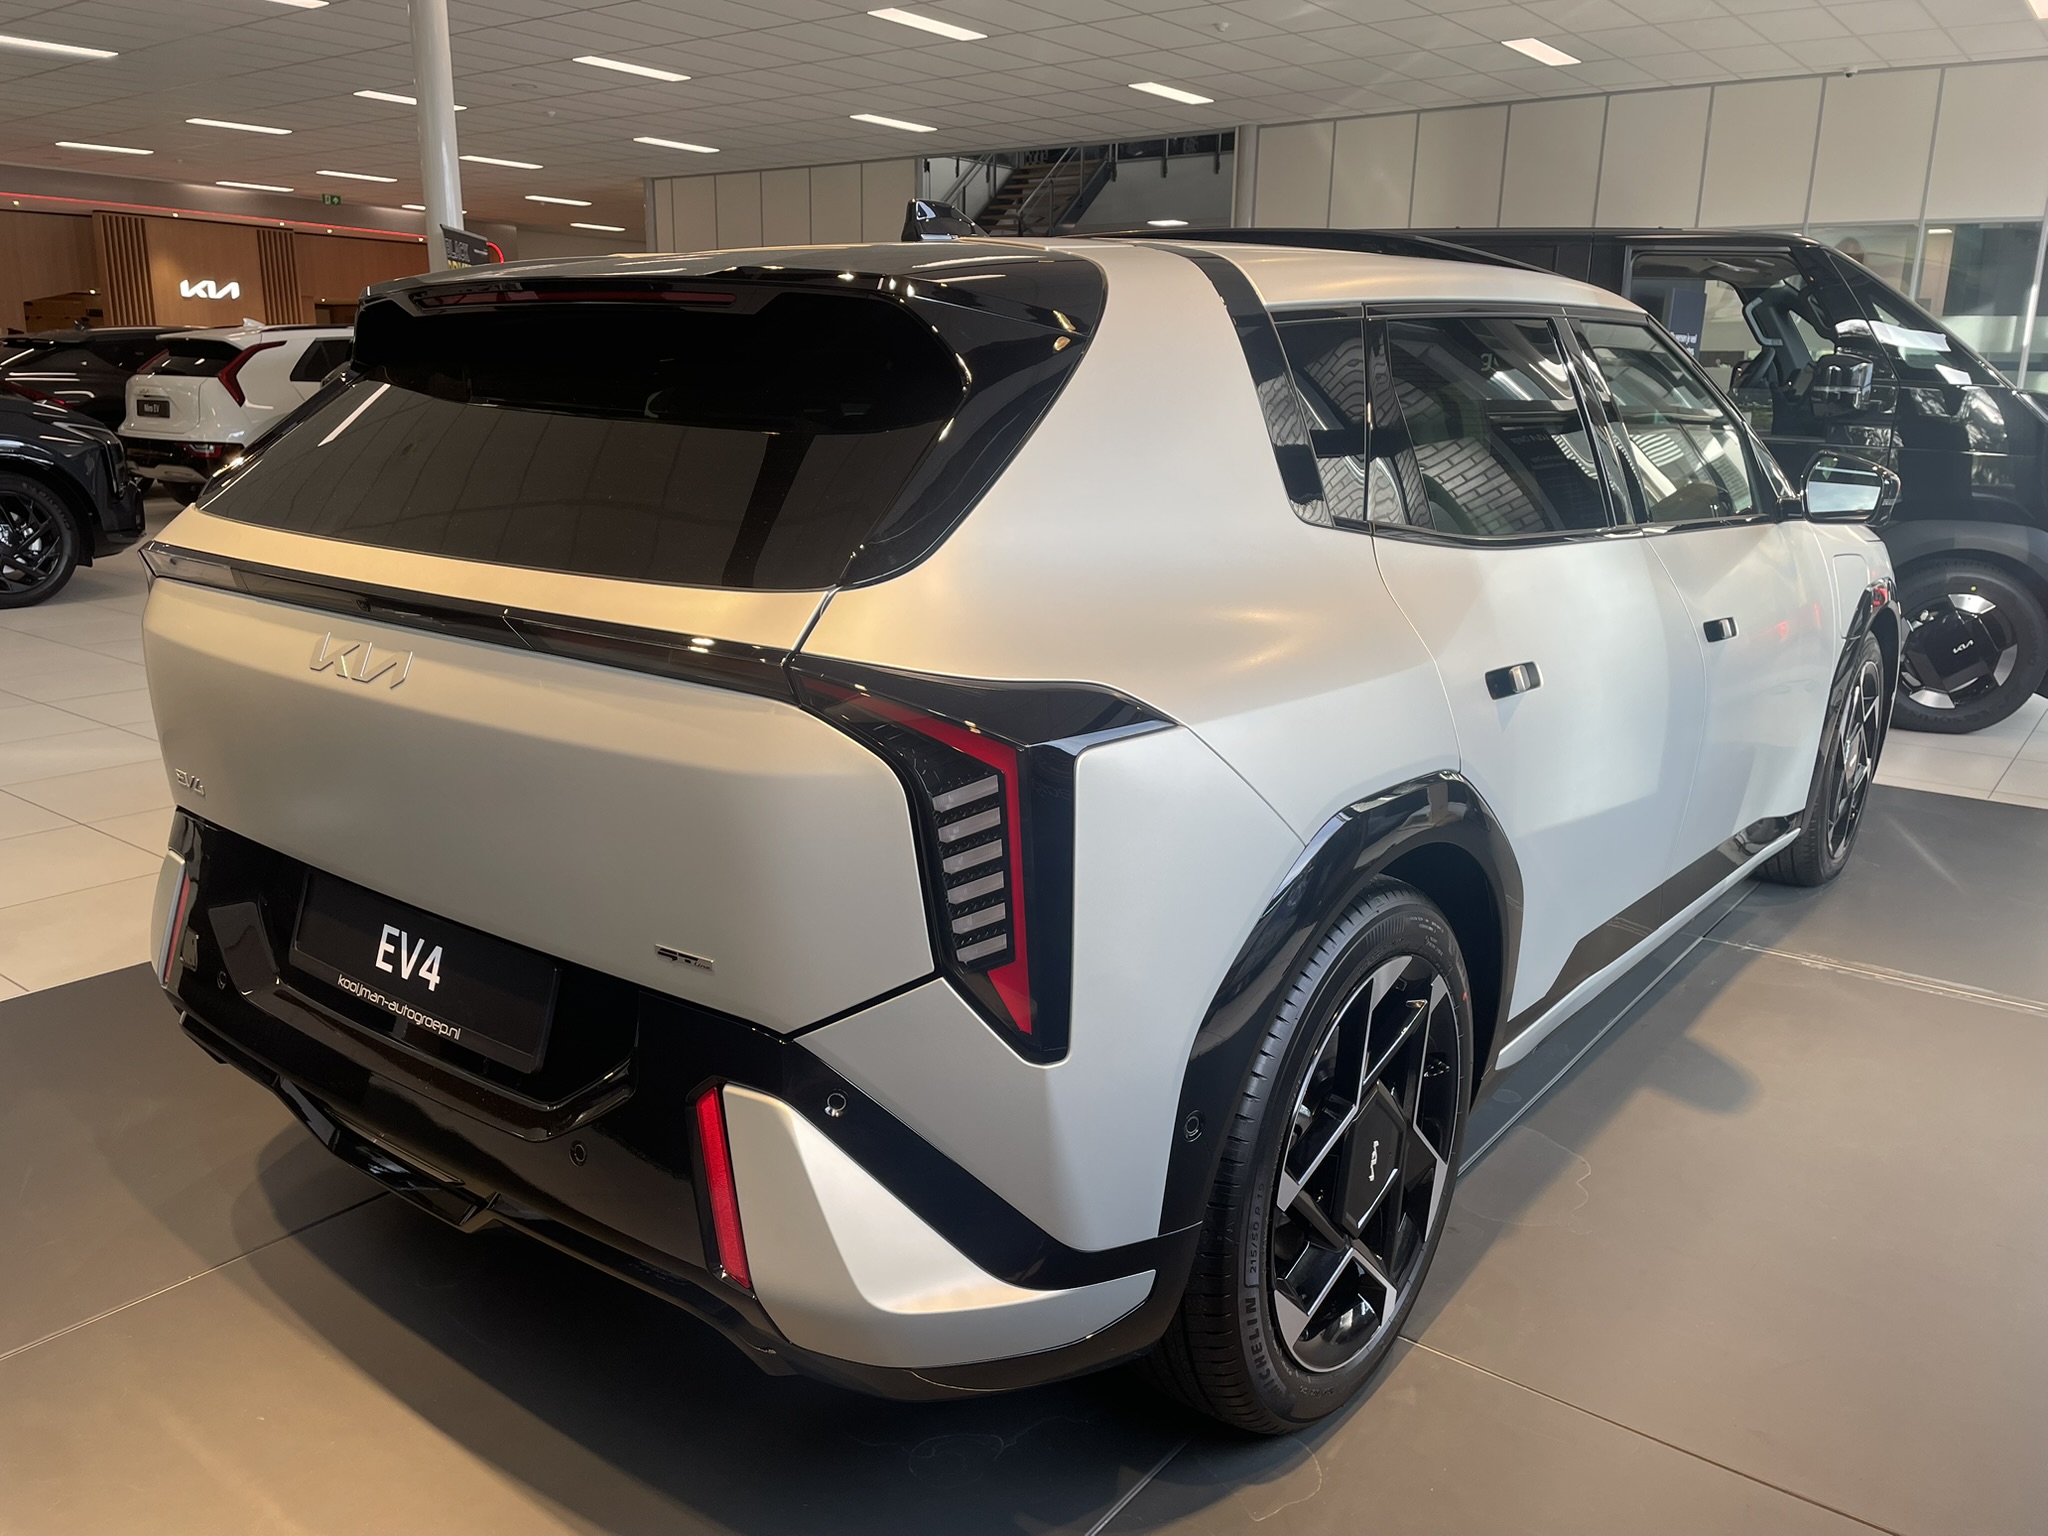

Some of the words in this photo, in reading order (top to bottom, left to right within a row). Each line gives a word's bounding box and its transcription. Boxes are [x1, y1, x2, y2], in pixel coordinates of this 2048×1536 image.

[179, 279, 241, 300] KIA
[153, 403, 160, 413] EV
[309, 631, 413, 690] KIA
[1952, 639, 1974, 654] KIA
[175, 768, 206, 796] EV4
[375, 923, 443, 992] EV4
[338, 973, 461, 1041] kooijman-autogroep.nl
[1248, 1221, 1260, 1274] 215/50
[1245, 1297, 1282, 1396] MICHELIN
